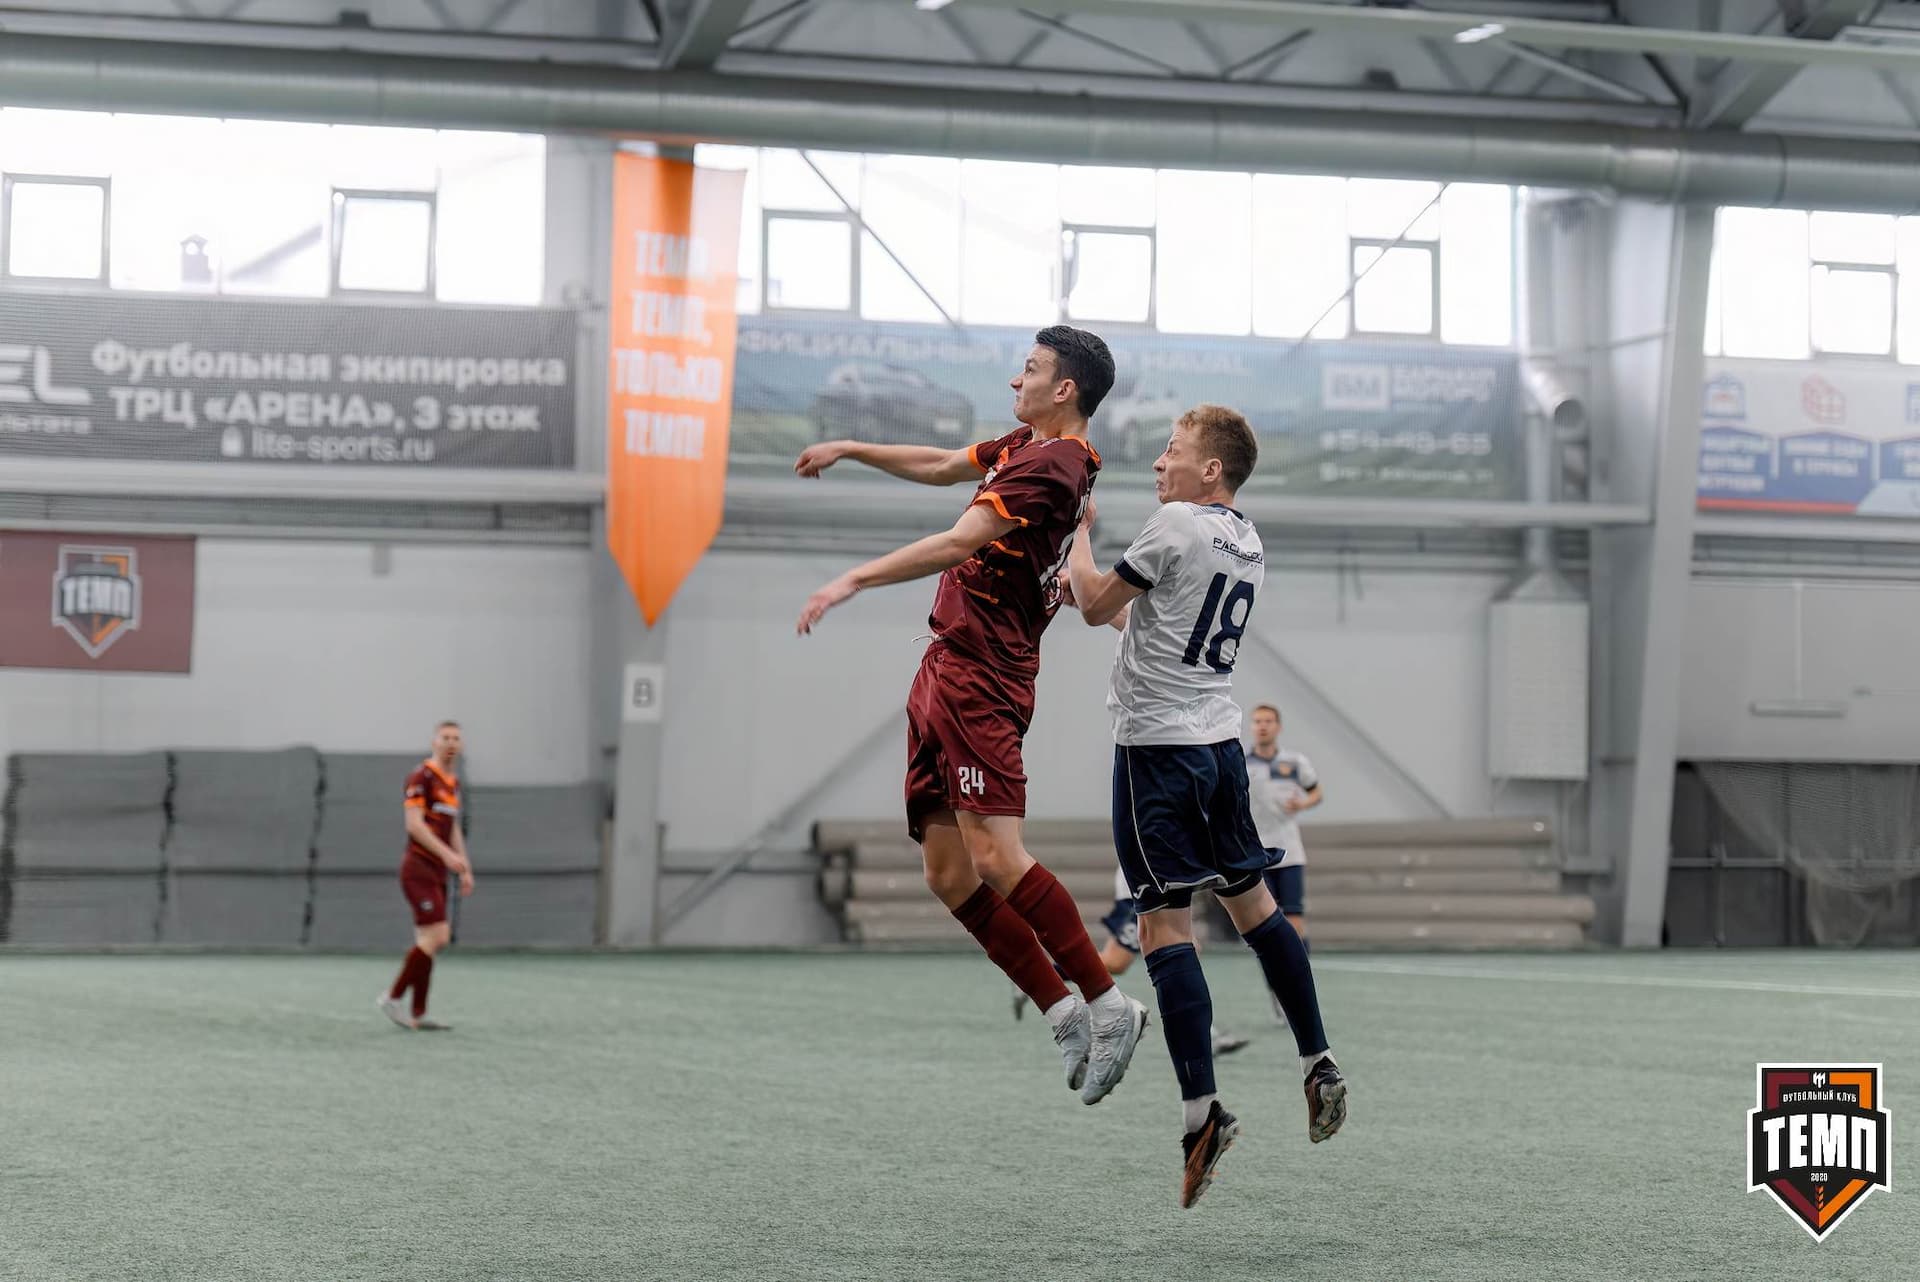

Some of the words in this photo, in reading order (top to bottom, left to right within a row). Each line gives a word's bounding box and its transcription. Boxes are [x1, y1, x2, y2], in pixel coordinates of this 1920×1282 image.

[91, 339, 330, 384] Футбольная
[340, 354, 566, 393] экипировка
[613, 348, 723, 404] ТОЛЬКО
[109, 387, 197, 430] ТРЦ
[203, 389, 406, 434] «АРЕНА»,
[413, 395, 441, 430] 3
[447, 403, 541, 432] этаж
[62, 575, 131, 617] ТЕМП
[1181, 571, 1254, 674] 18
[958, 766, 985, 795] 24
